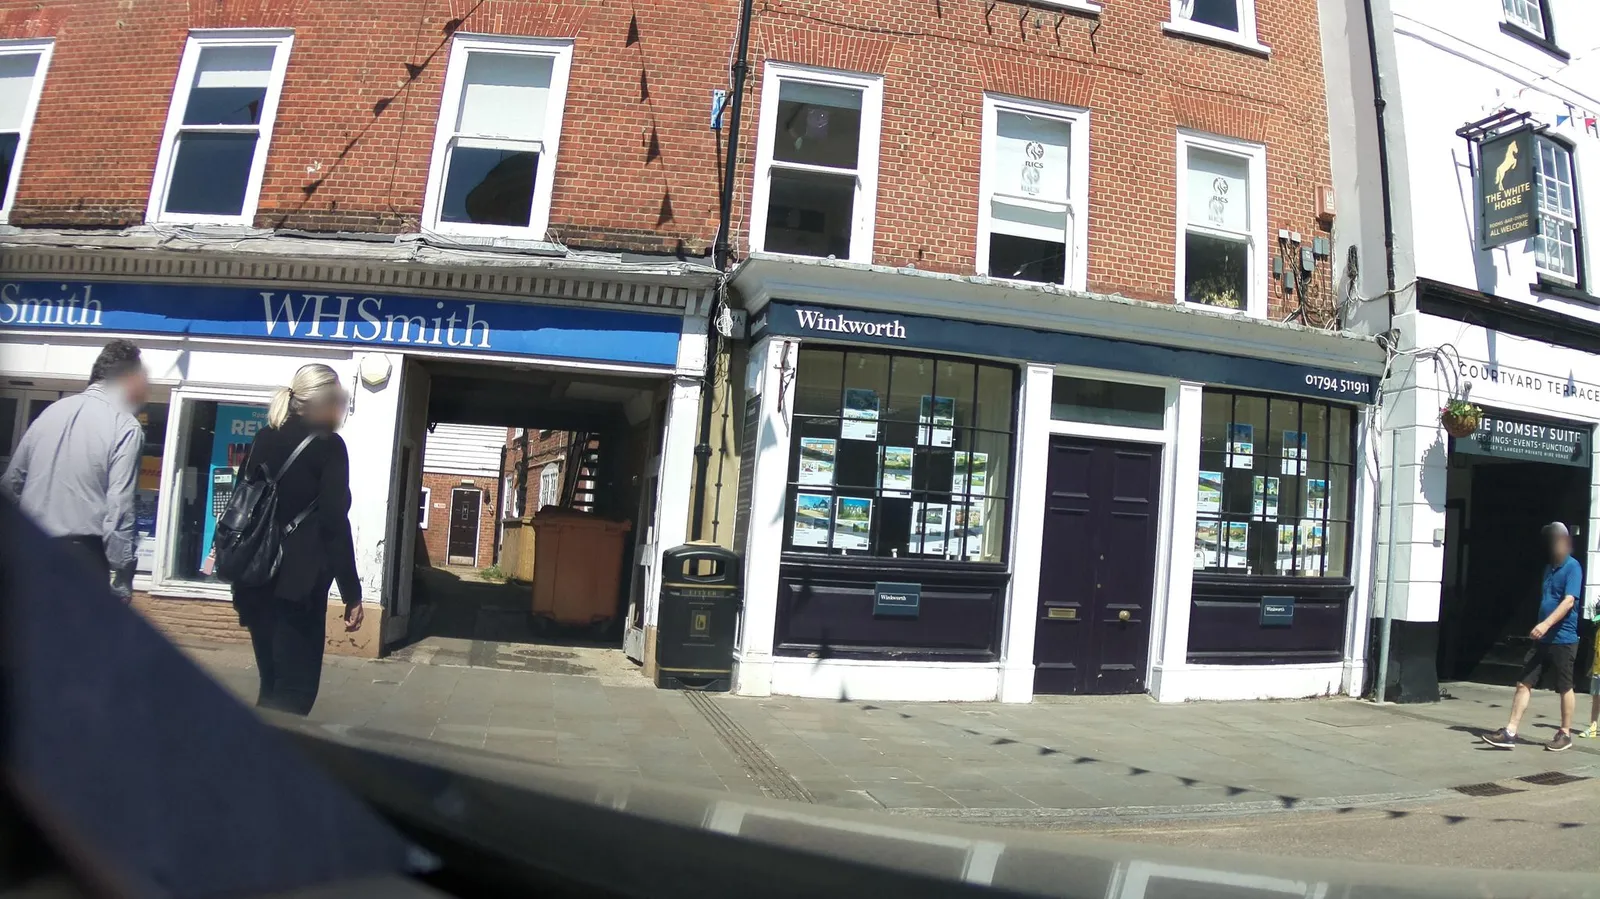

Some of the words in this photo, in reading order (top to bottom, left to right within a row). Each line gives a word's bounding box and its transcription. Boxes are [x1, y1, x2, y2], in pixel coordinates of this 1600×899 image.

[1485, 192, 1502, 204] THE
[1503, 182, 1530, 198] WHITE
[1494, 195, 1522, 210] HORSE
[1490, 228, 1500, 236] ALL
[1500, 220, 1528, 234] WELCOME
[259, 292, 492, 348] WHSmith
[796, 309, 906, 339] Winkworth
[1305, 374, 1338, 392] 01794
[1340, 380, 1370, 394] 511911
[1460, 363, 1542, 390] COURTYARD
[1548, 380, 1600, 402] TERRACE
[1496, 420, 1546, 438] ROMSEY
[1550, 428, 1580, 443] SUITE
